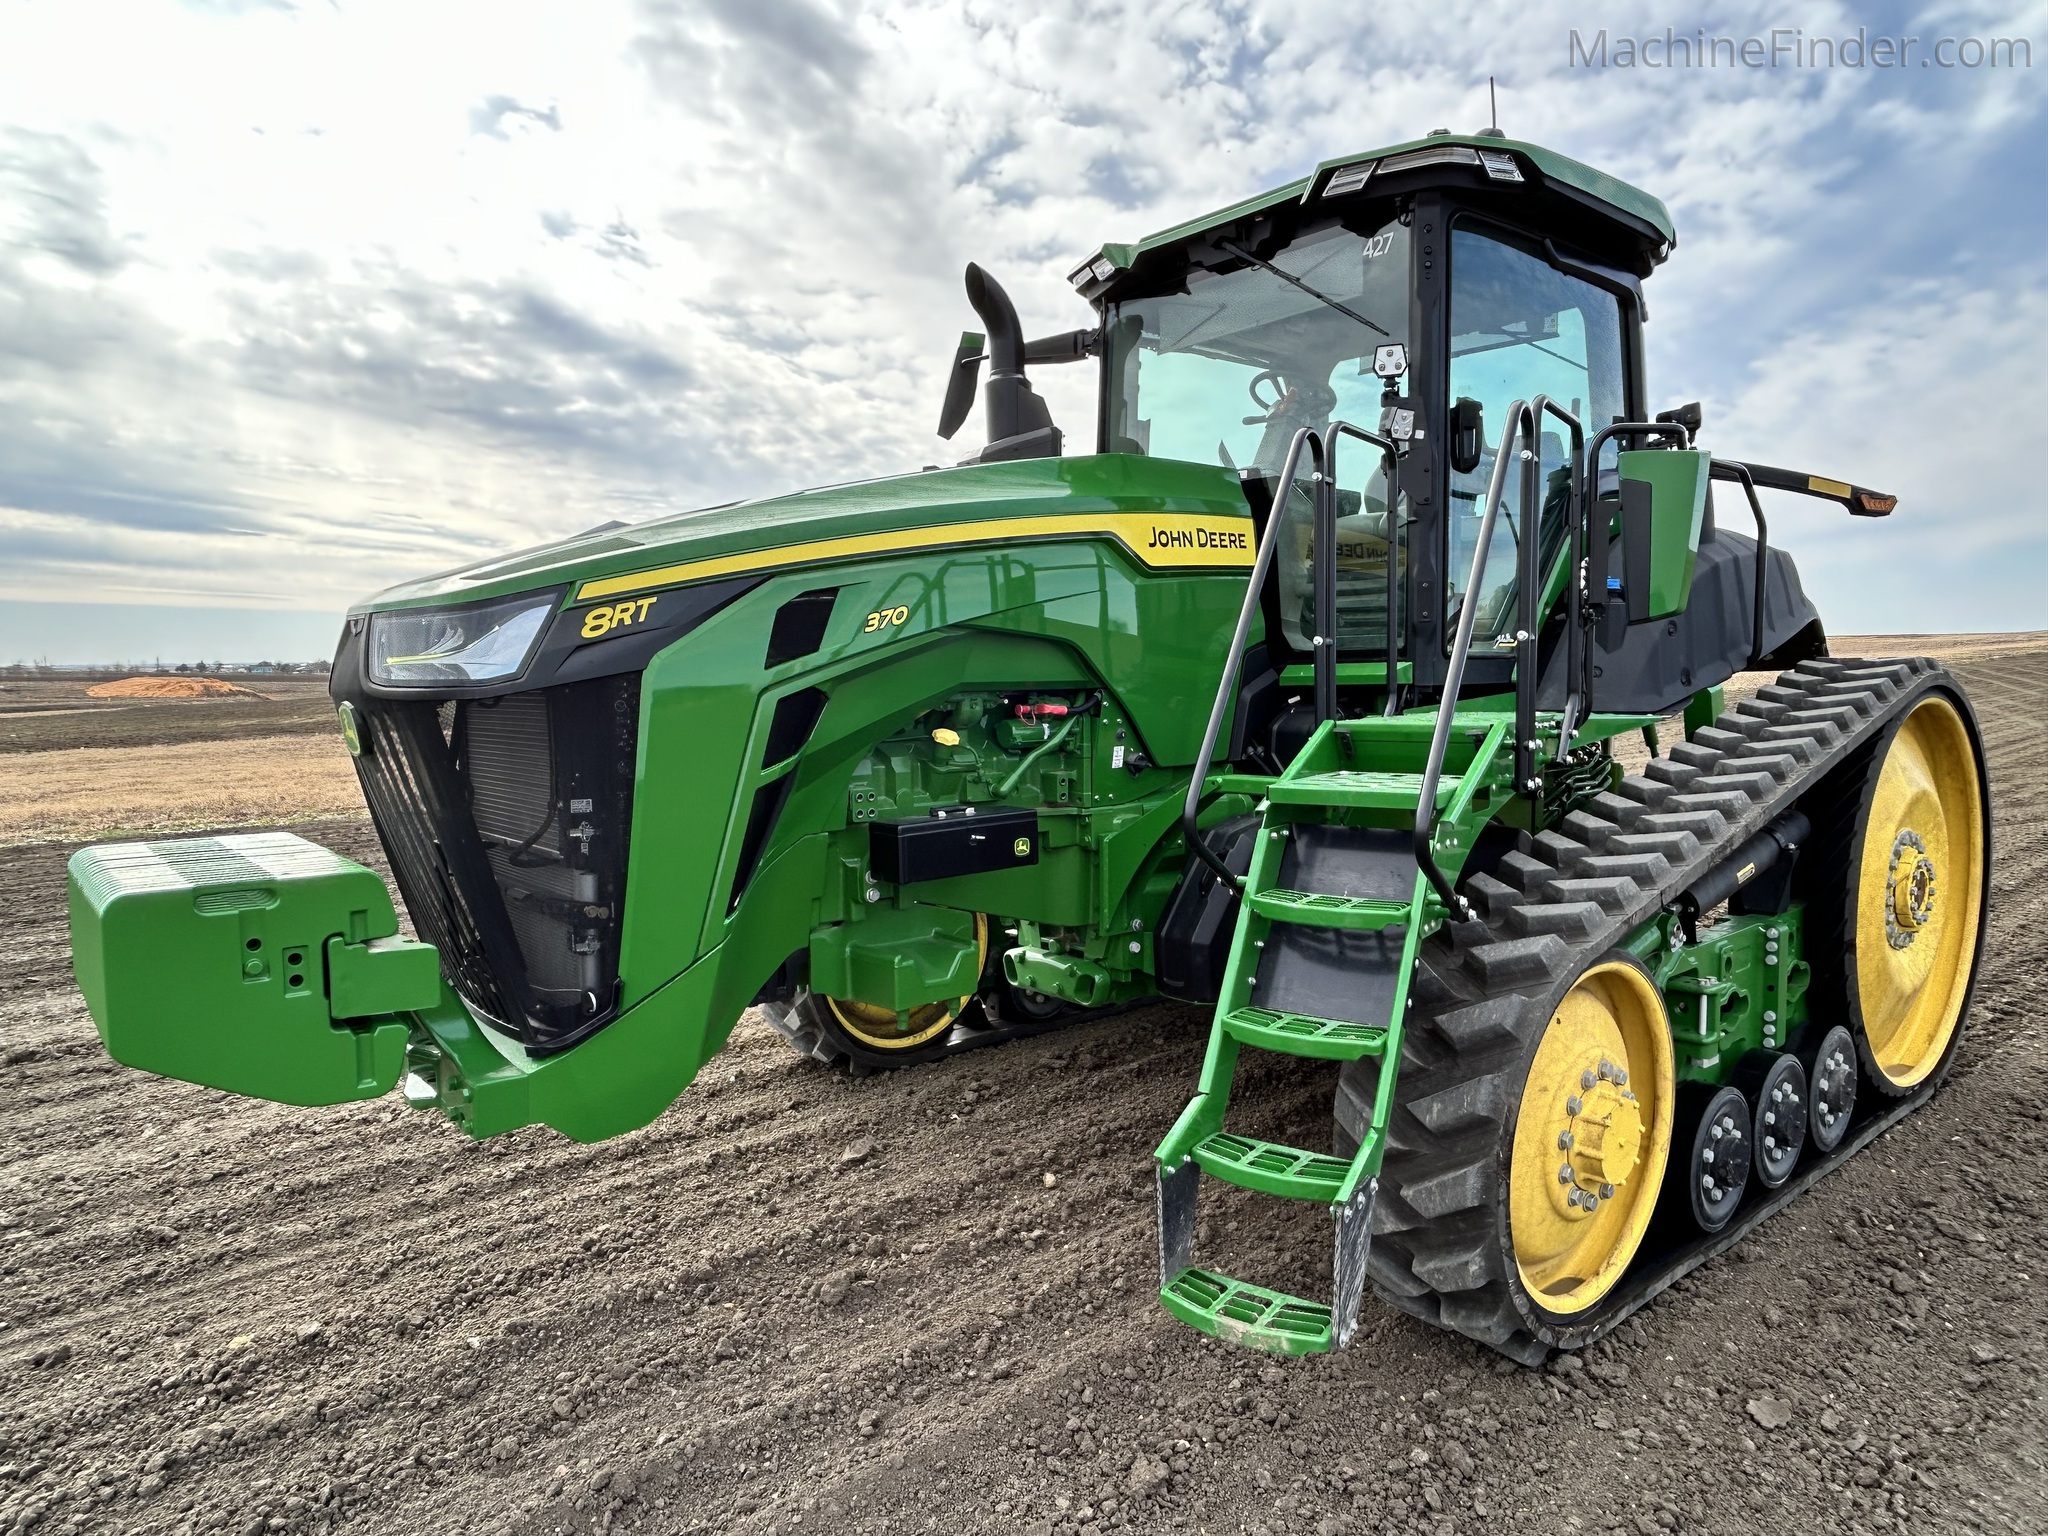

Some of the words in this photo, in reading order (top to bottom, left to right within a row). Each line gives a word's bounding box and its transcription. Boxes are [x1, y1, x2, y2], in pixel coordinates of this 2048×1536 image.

[1362, 231, 1394, 258] 427
[1149, 527, 1193, 548] JOHN
[1196, 528, 1247, 549] DEERE
[581, 597, 658, 638] 8RT
[864, 605, 909, 633] 370
